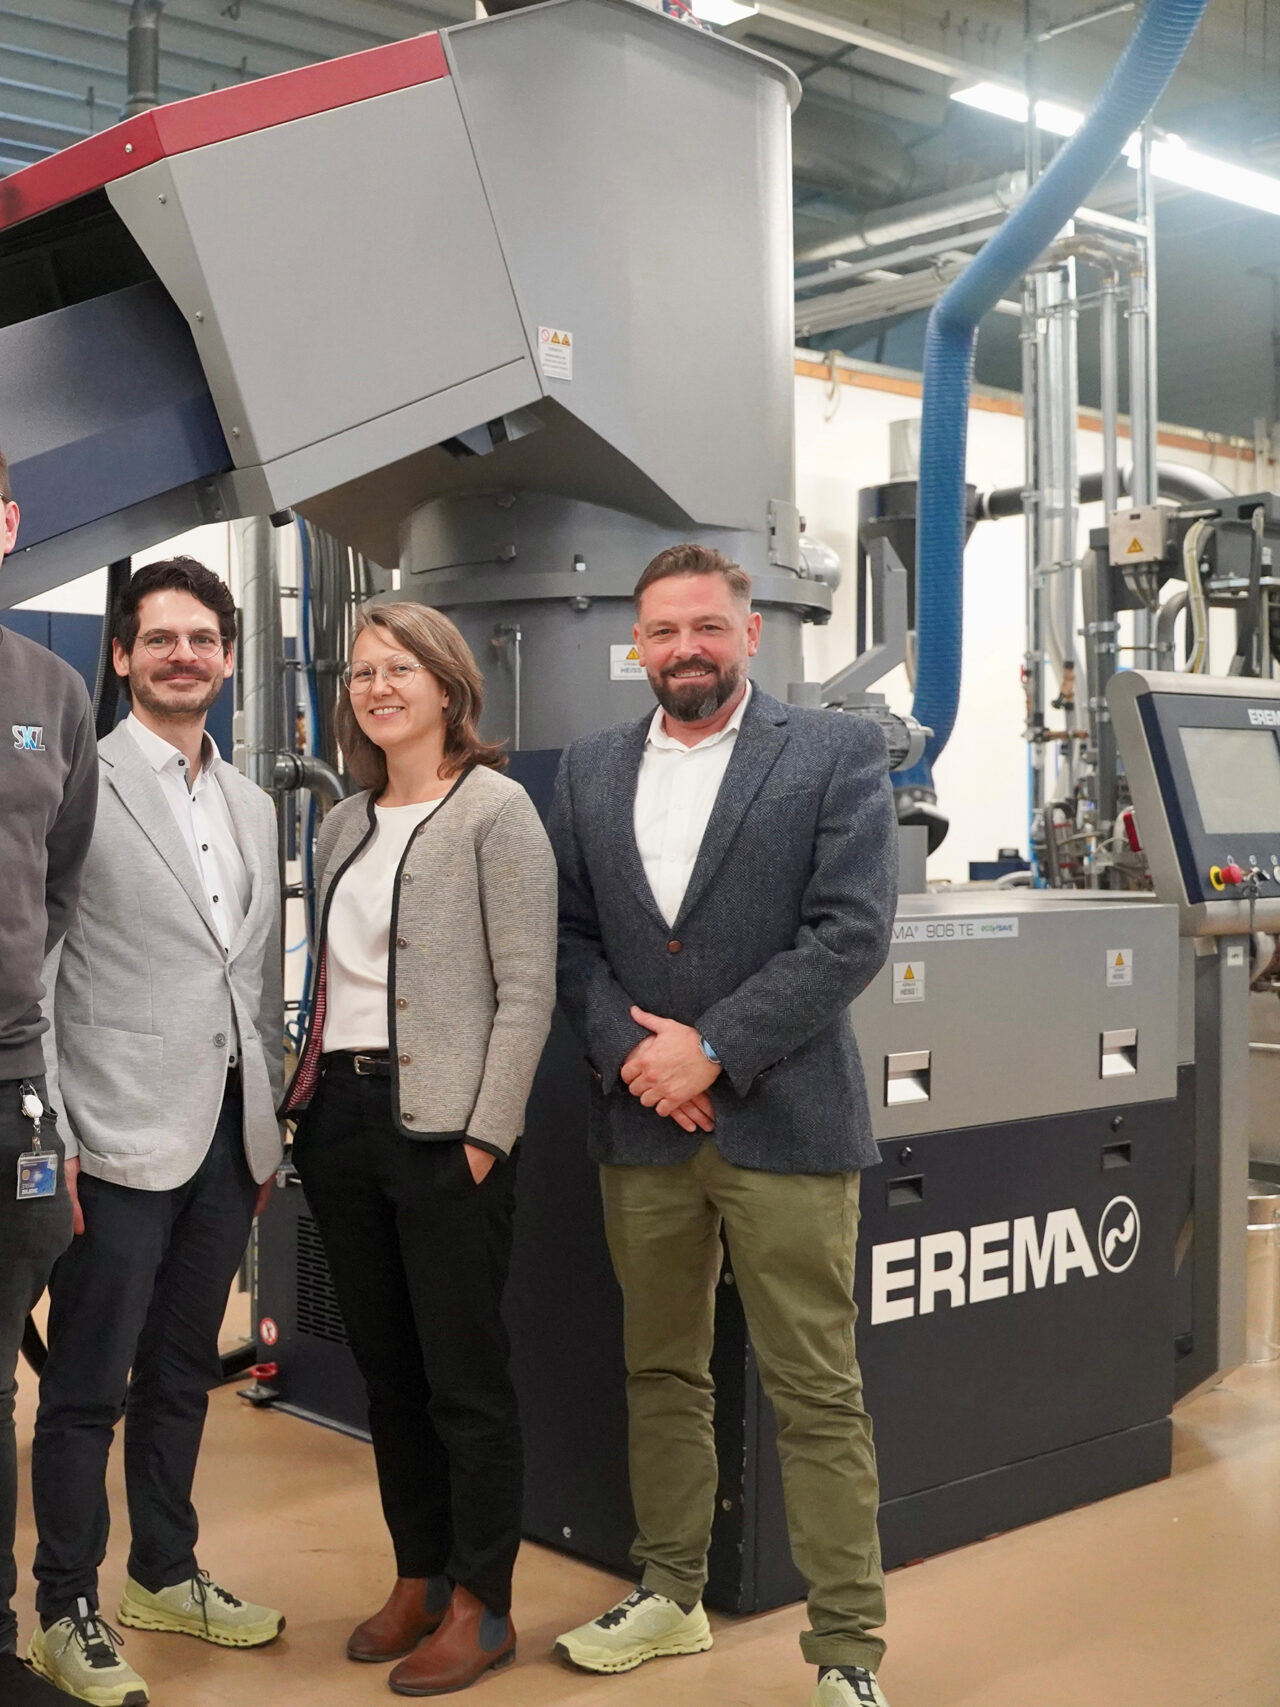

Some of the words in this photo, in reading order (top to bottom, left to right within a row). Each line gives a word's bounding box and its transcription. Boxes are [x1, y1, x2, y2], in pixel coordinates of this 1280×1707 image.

[1248, 709, 1280, 725] EREM
[926, 923, 955, 938] 906
[958, 923, 974, 937] TE
[871, 1208, 1099, 1325] EREMA
